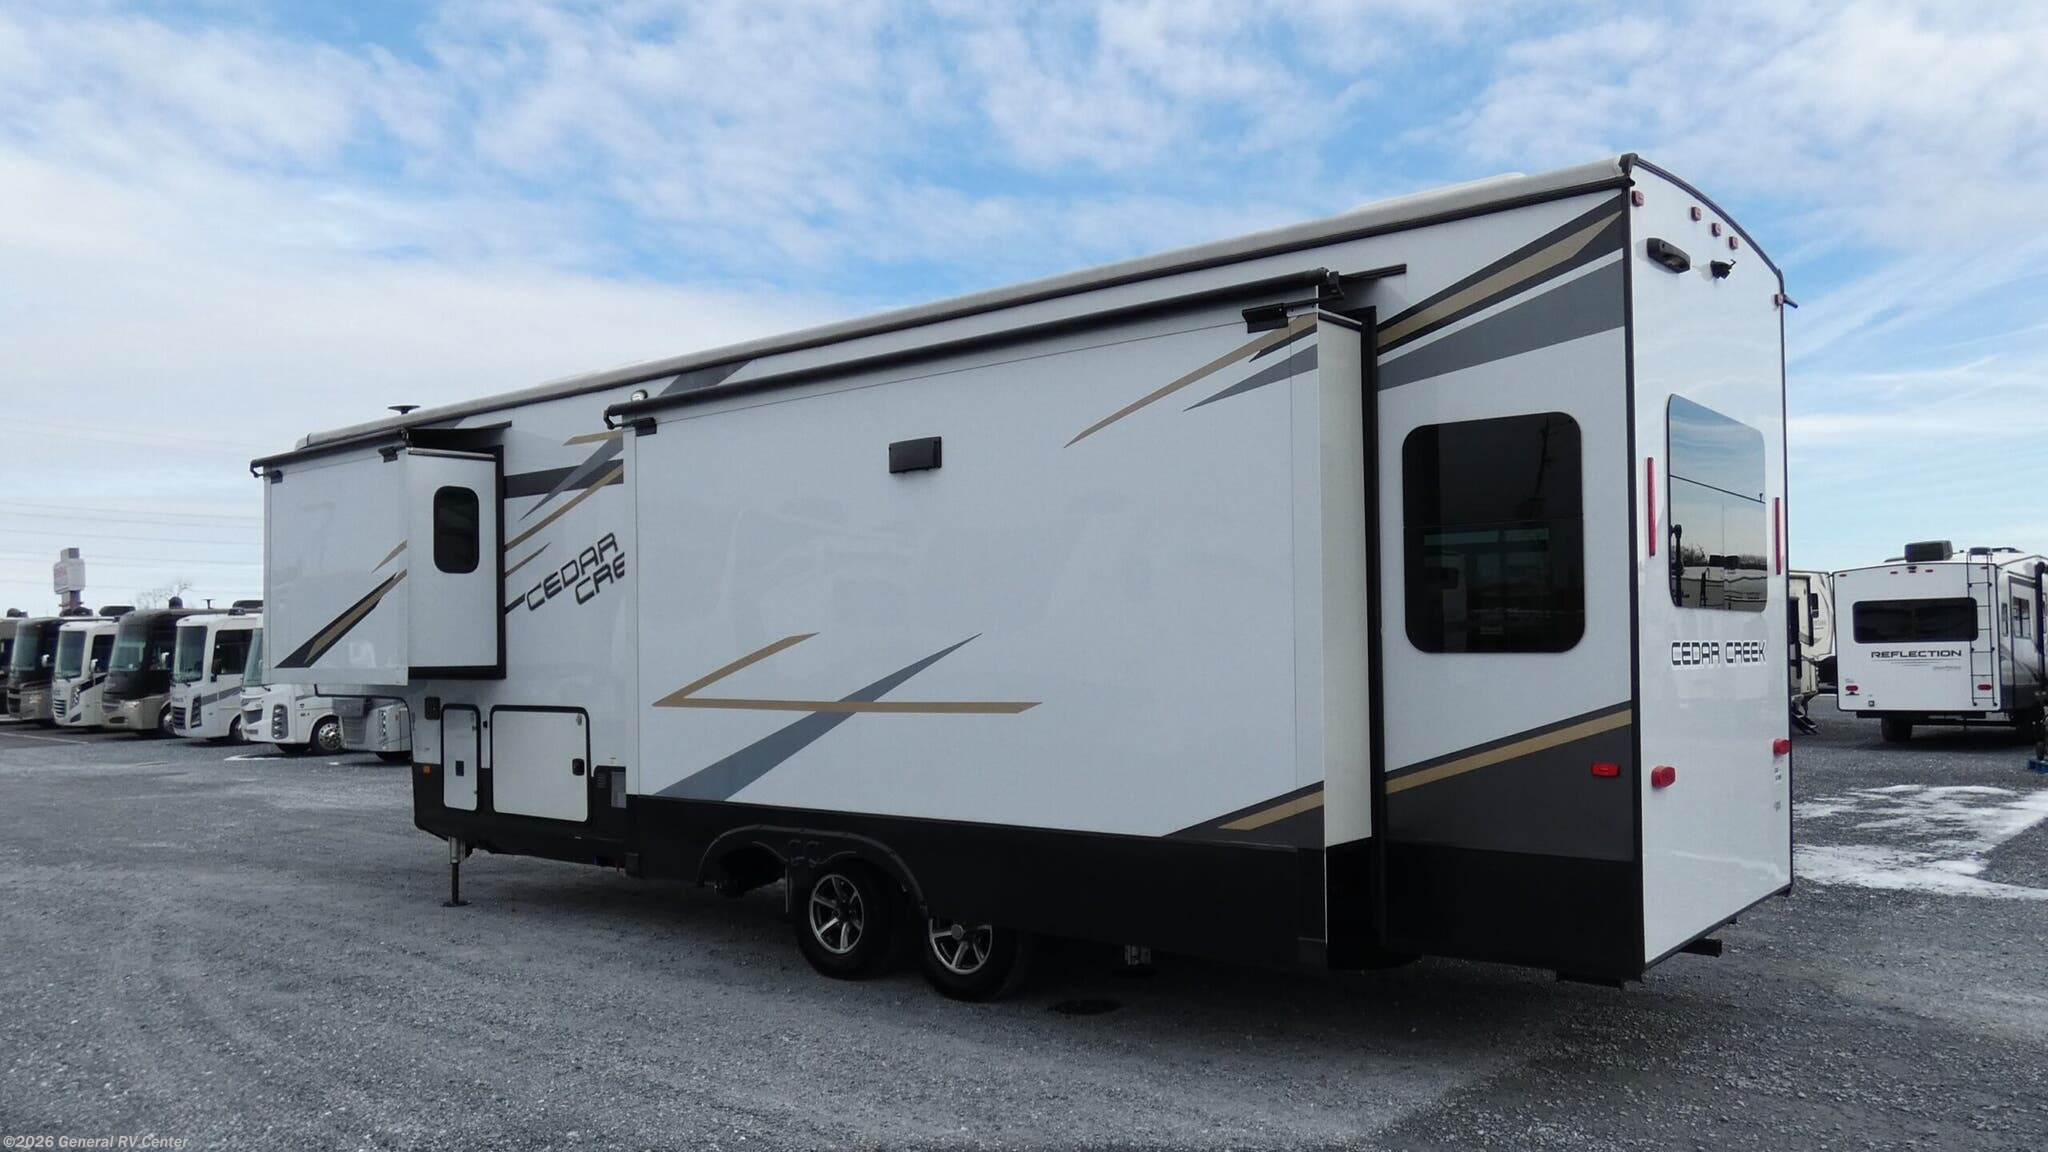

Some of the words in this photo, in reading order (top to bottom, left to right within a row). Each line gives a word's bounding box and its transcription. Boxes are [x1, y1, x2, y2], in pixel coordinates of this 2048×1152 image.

[526, 532, 618, 611] CEDAR
[1671, 641, 1720, 666] CEDAR
[1725, 641, 1766, 664] CREEK
[1871, 649, 1962, 659] REFLECTION
